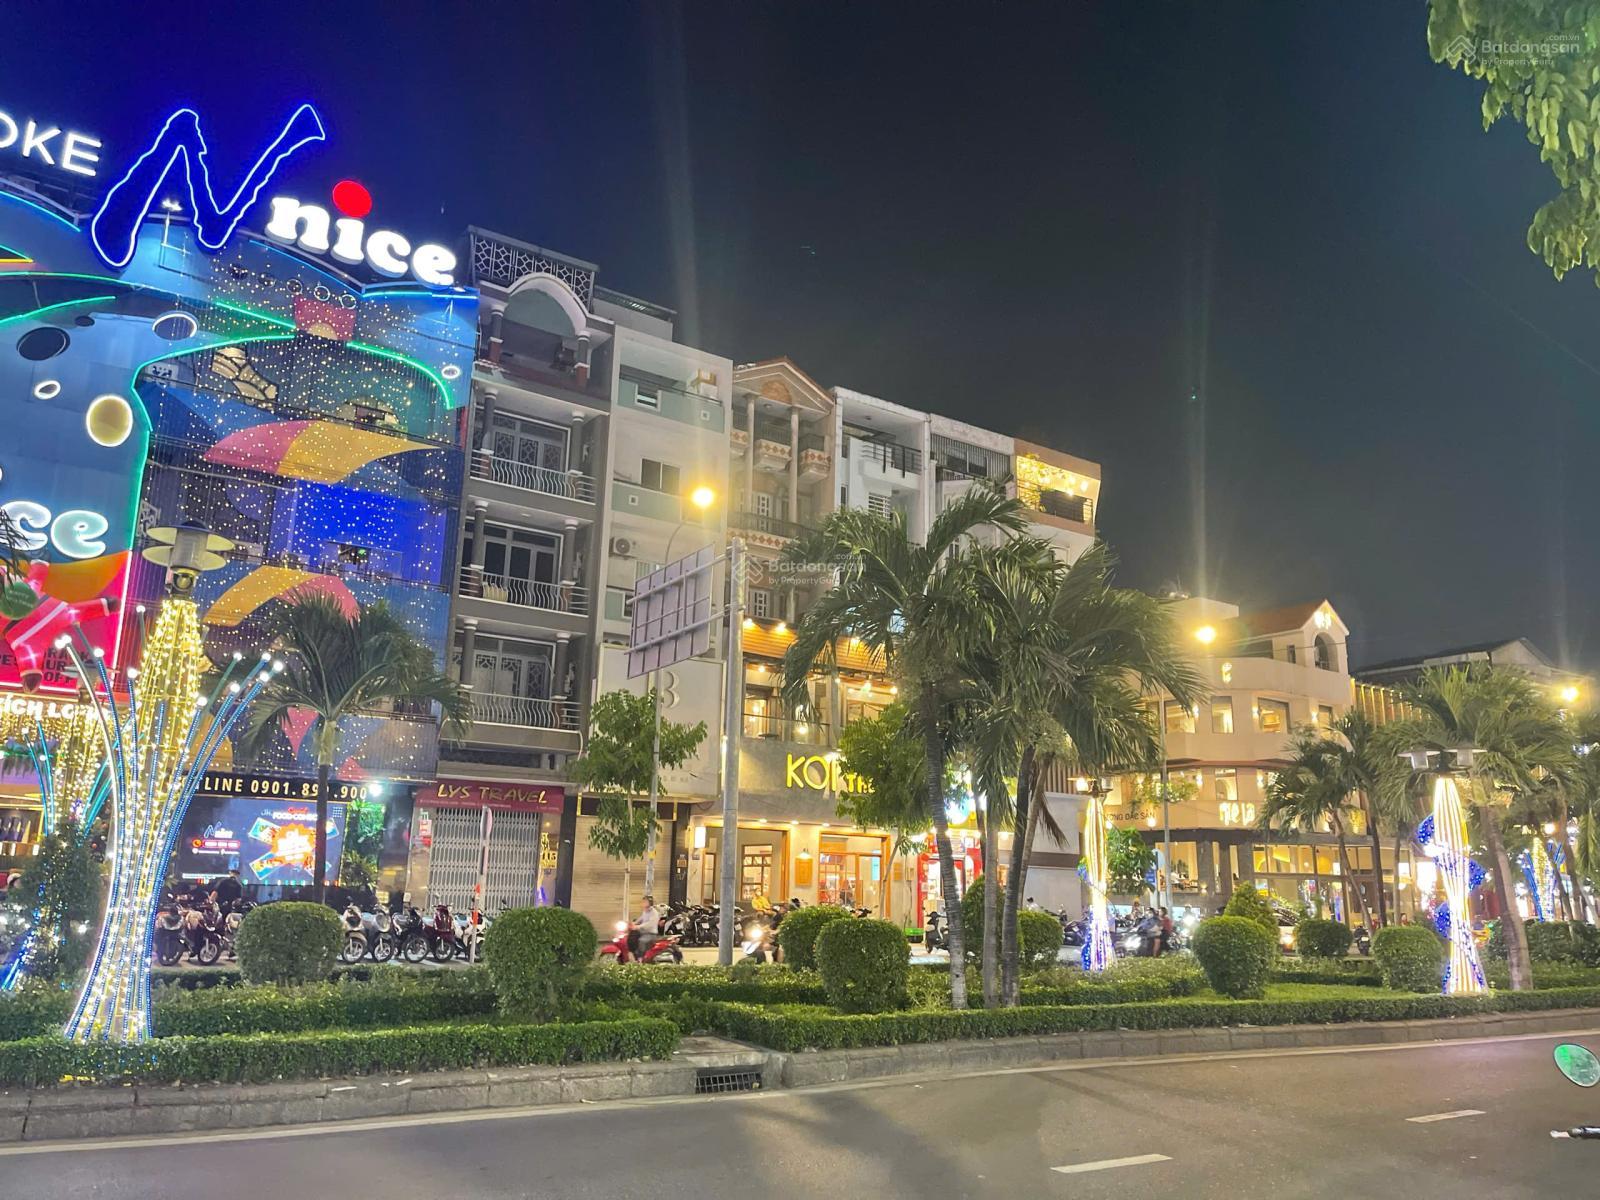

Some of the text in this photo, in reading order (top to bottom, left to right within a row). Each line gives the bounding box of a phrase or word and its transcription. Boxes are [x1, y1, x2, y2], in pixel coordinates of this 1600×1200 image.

[265, 180, 458, 288] nice
[786, 753, 837, 792] KOI
[250, 779, 367, 799] 0901.89.900
[437, 784, 548, 803] LYS TRAVEL
